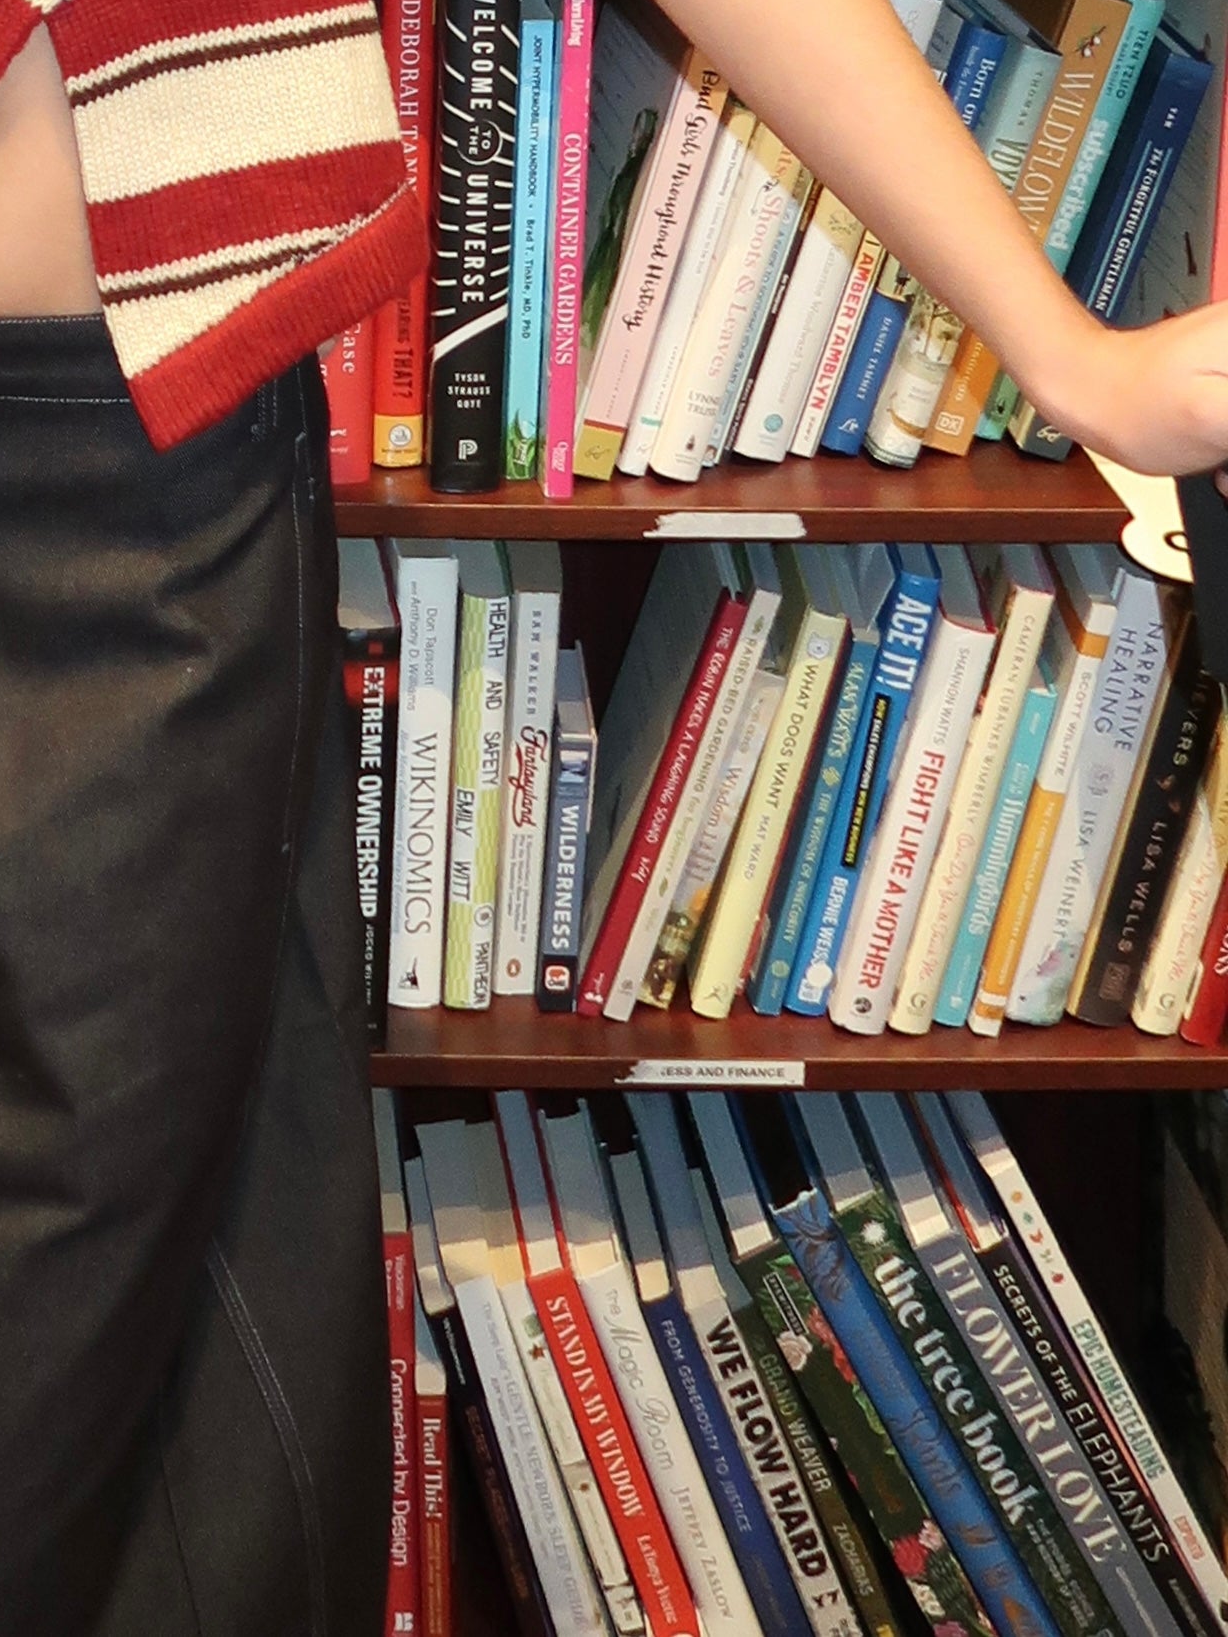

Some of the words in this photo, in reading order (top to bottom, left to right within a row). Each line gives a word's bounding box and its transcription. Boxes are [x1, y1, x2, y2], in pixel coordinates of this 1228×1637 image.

[462, 172, 489, 306] UNIVERSE
[561, 132, 583, 260] CONTAINER
[653, 158, 693, 260] Throughout
[1048, 118, 1110, 252] subscribed
[555, 264, 578, 366] GARDENS
[841, 253, 875, 319] AMBER
[810, 321, 850, 411] TAMBLYN
[487, 600, 507, 659] HEALTH
[1093, 627, 1140, 736] HEALING
[360, 665, 385, 771] EXTREME
[778, 713, 805, 759] DOGS
[1113, 620, 1166, 753] NARRATIVE
[481, 731, 503, 787] SAFETY
[902, 749, 946, 825] FIGHT
[355, 773, 384, 918] OWNERSHIP
[403, 731, 439, 936] WIKINOMICS
[551, 804, 580, 951] WILDERNESS
[888, 825, 926, 878] LIKE
[856, 898, 903, 989] MOTHER
[728, 1067, 785, 1078] FINANCE
[546, 1295, 586, 1366] STAND
[595, 1426, 646, 1518] WINDOW
[909, 1329, 973, 1417] tree
[958, 1412, 1040, 1527] book
[930, 1249, 1055, 1438] FLOWER
[1036, 1440, 1129, 1564] LOVE
[728, 1383, 787, 1483] FLOW
[768, 1483, 829, 1578] HARD
[1066, 1403, 1171, 1562] ELEPHANTS
